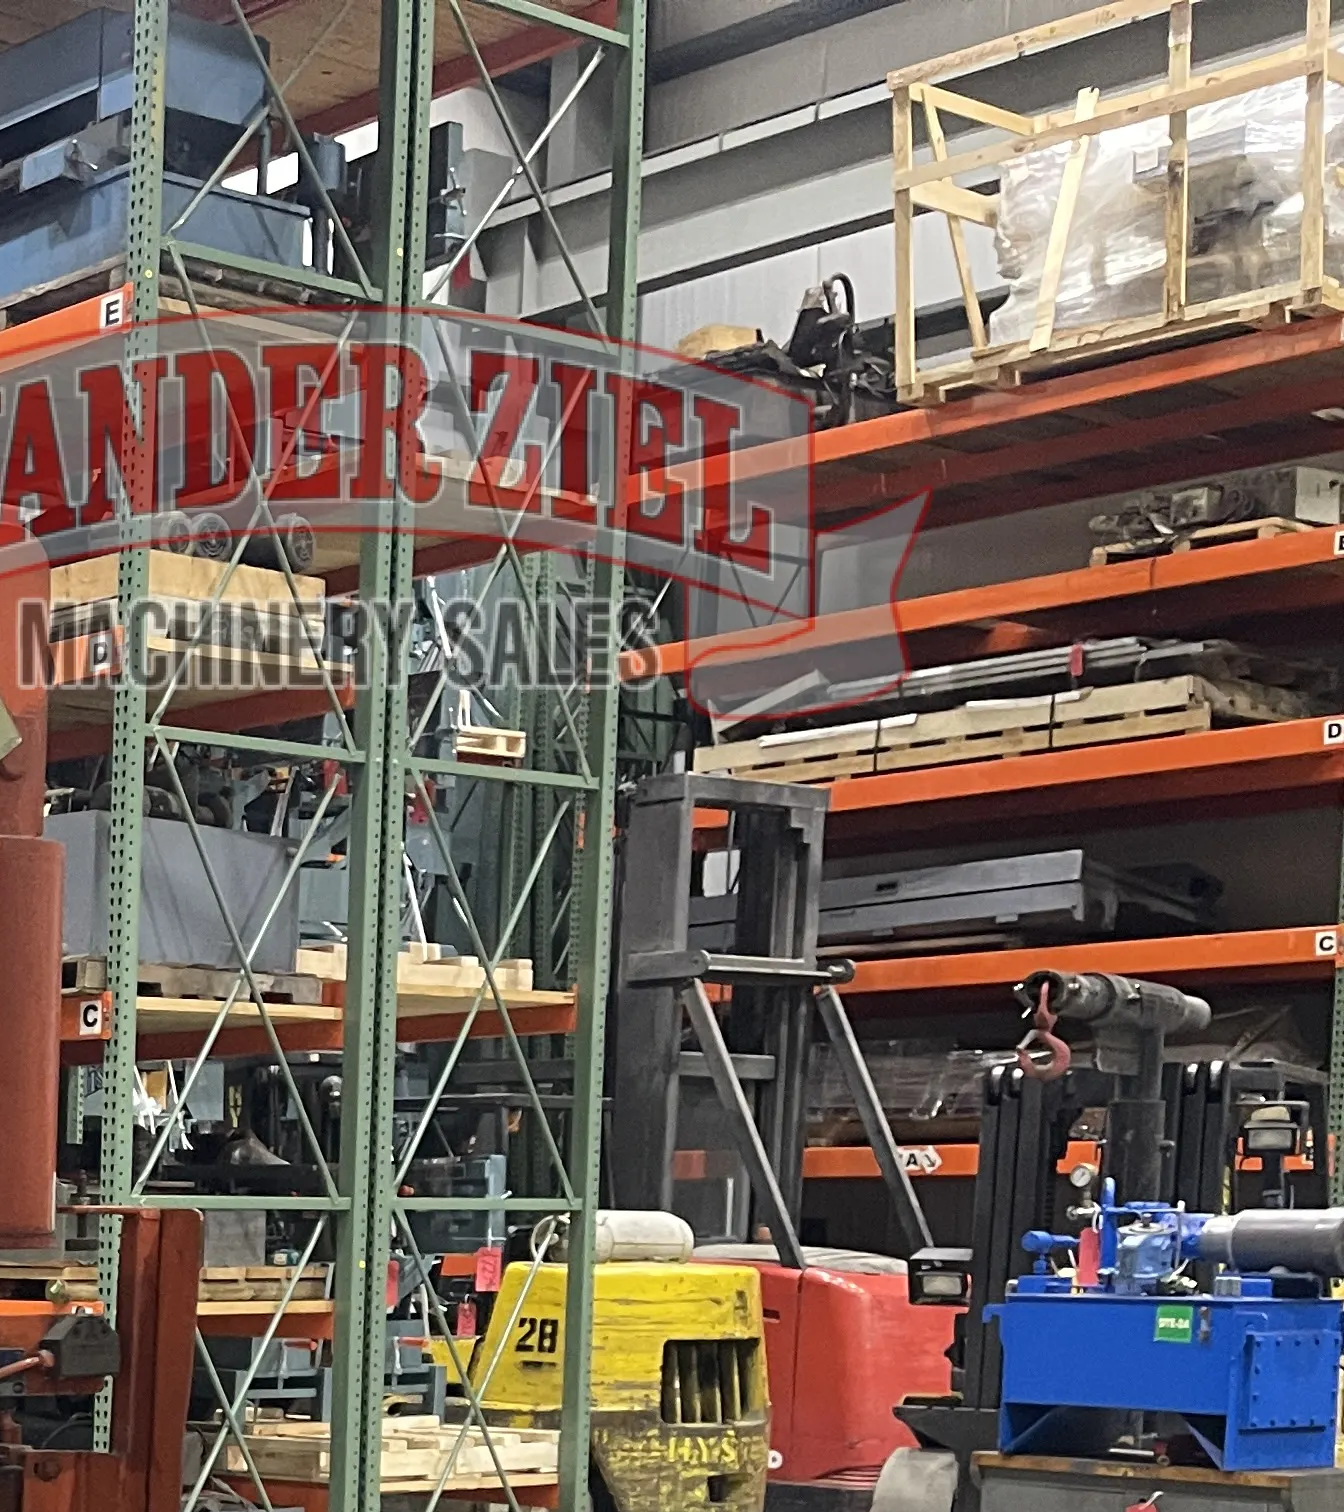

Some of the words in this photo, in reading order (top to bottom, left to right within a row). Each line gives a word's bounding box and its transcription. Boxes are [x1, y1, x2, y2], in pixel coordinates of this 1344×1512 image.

[105, 299, 120, 327] E
[1327, 722, 1342, 739] D
[1319, 935, 1334, 952] C
[82, 1003, 99, 1028] C
[905, 1152, 918, 1168] A
